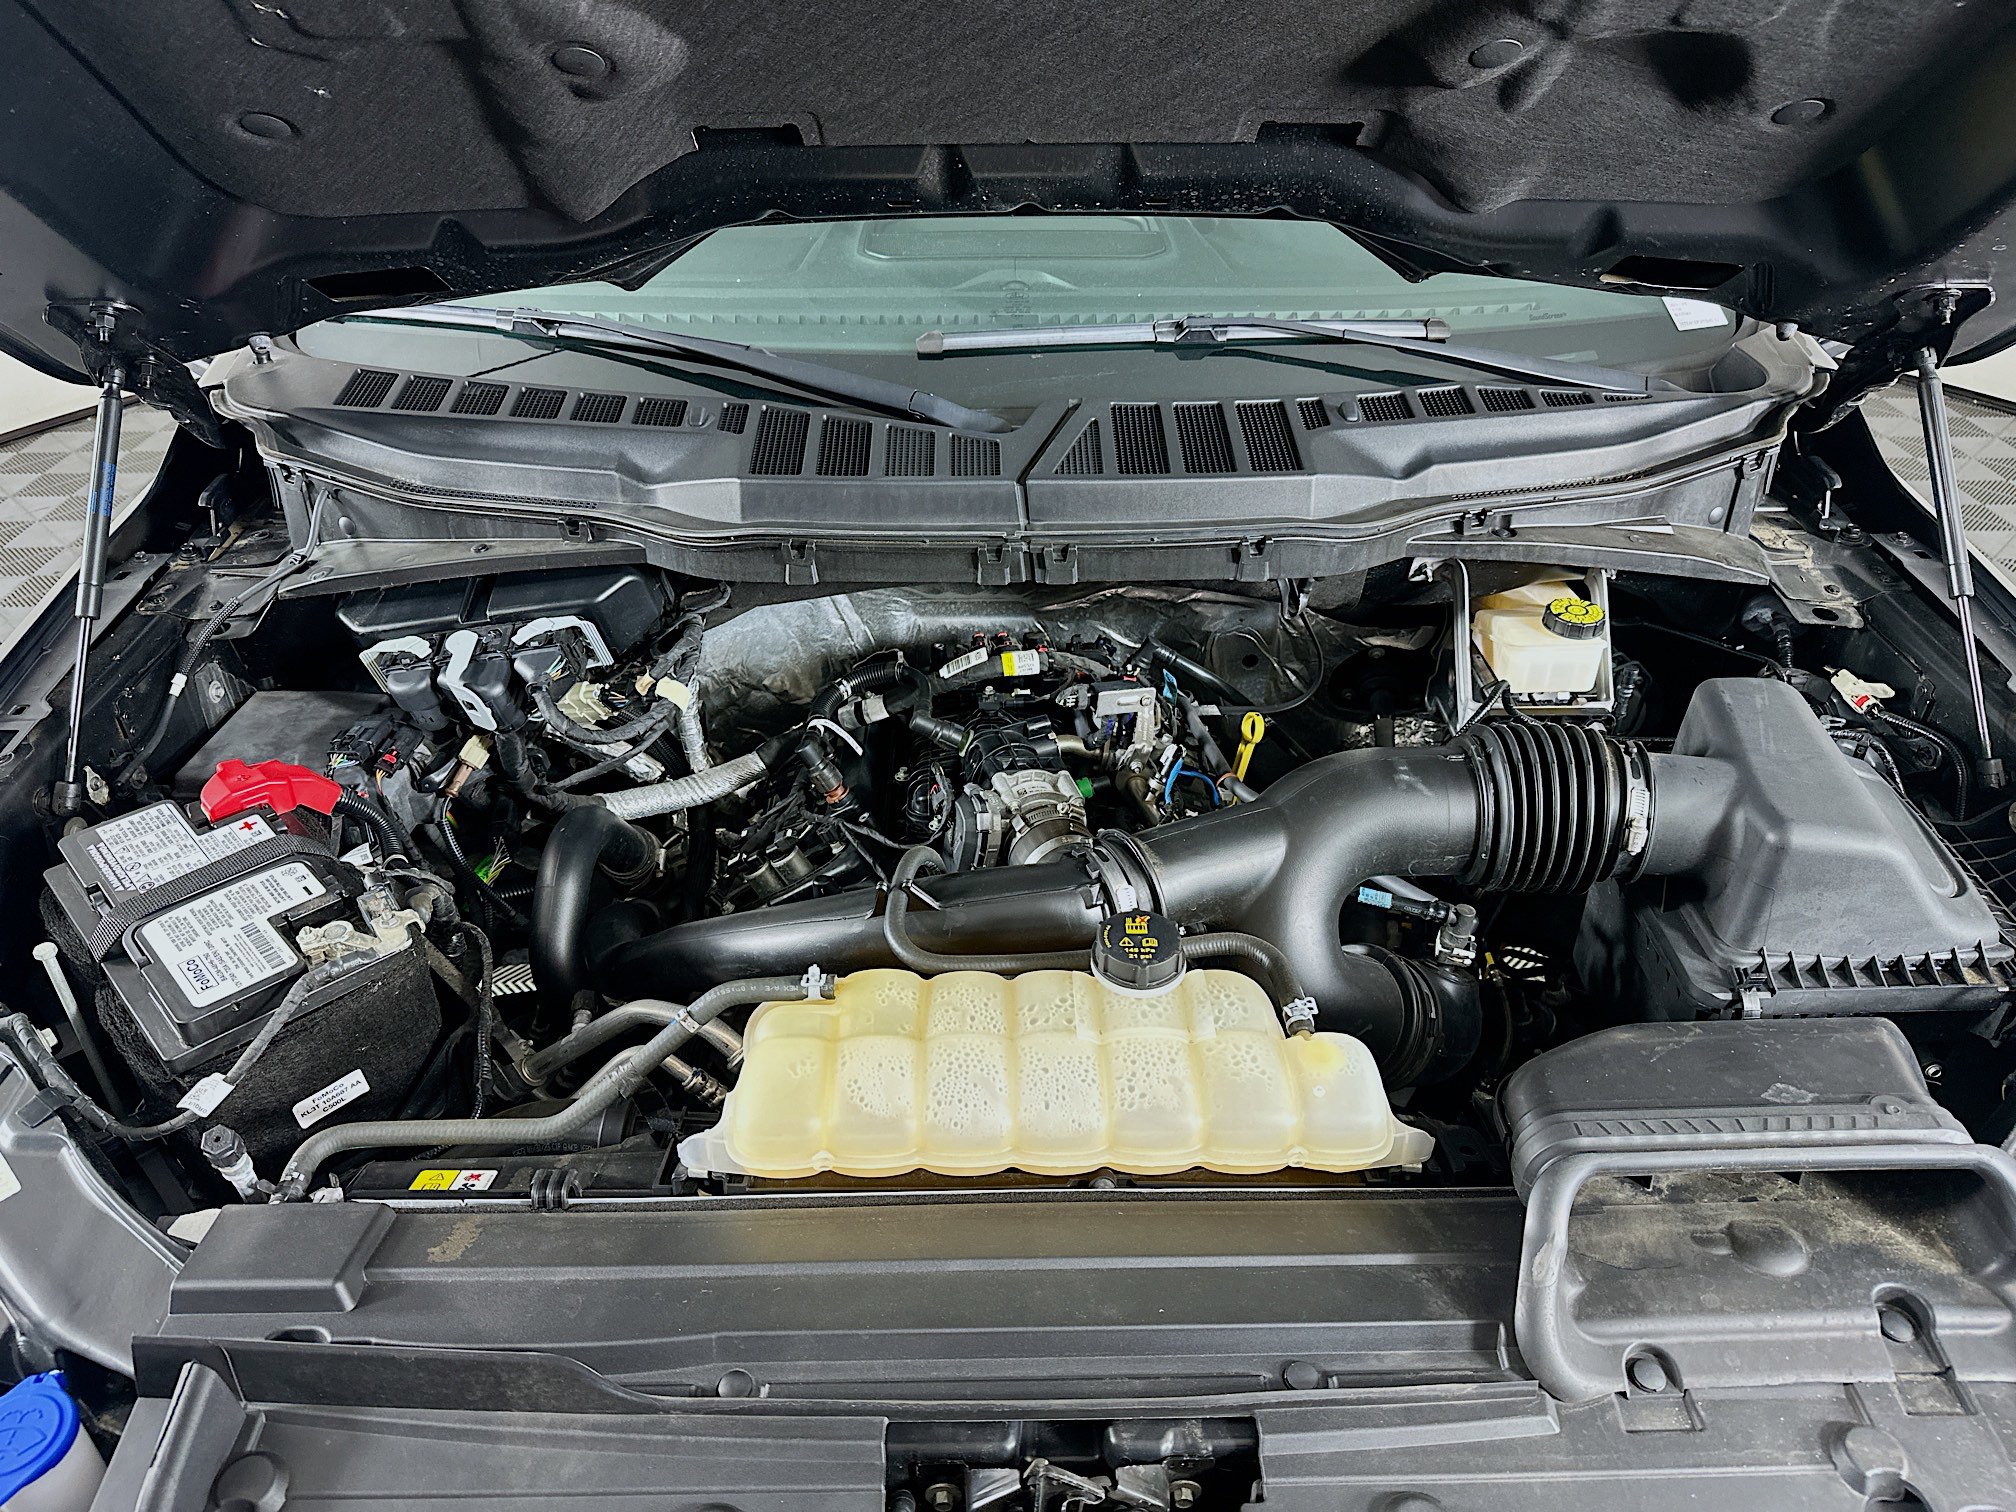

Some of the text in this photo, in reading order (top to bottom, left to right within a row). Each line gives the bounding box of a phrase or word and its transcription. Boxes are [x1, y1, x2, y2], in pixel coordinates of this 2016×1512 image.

[186, 959, 213, 991] FoMoCo
[300, 1104, 320, 1118] KL3T
[350, 1079, 362, 1089] AA
[312, 1083, 344, 1104] FoMoCo
[322, 1097, 347, 1113] C500L
